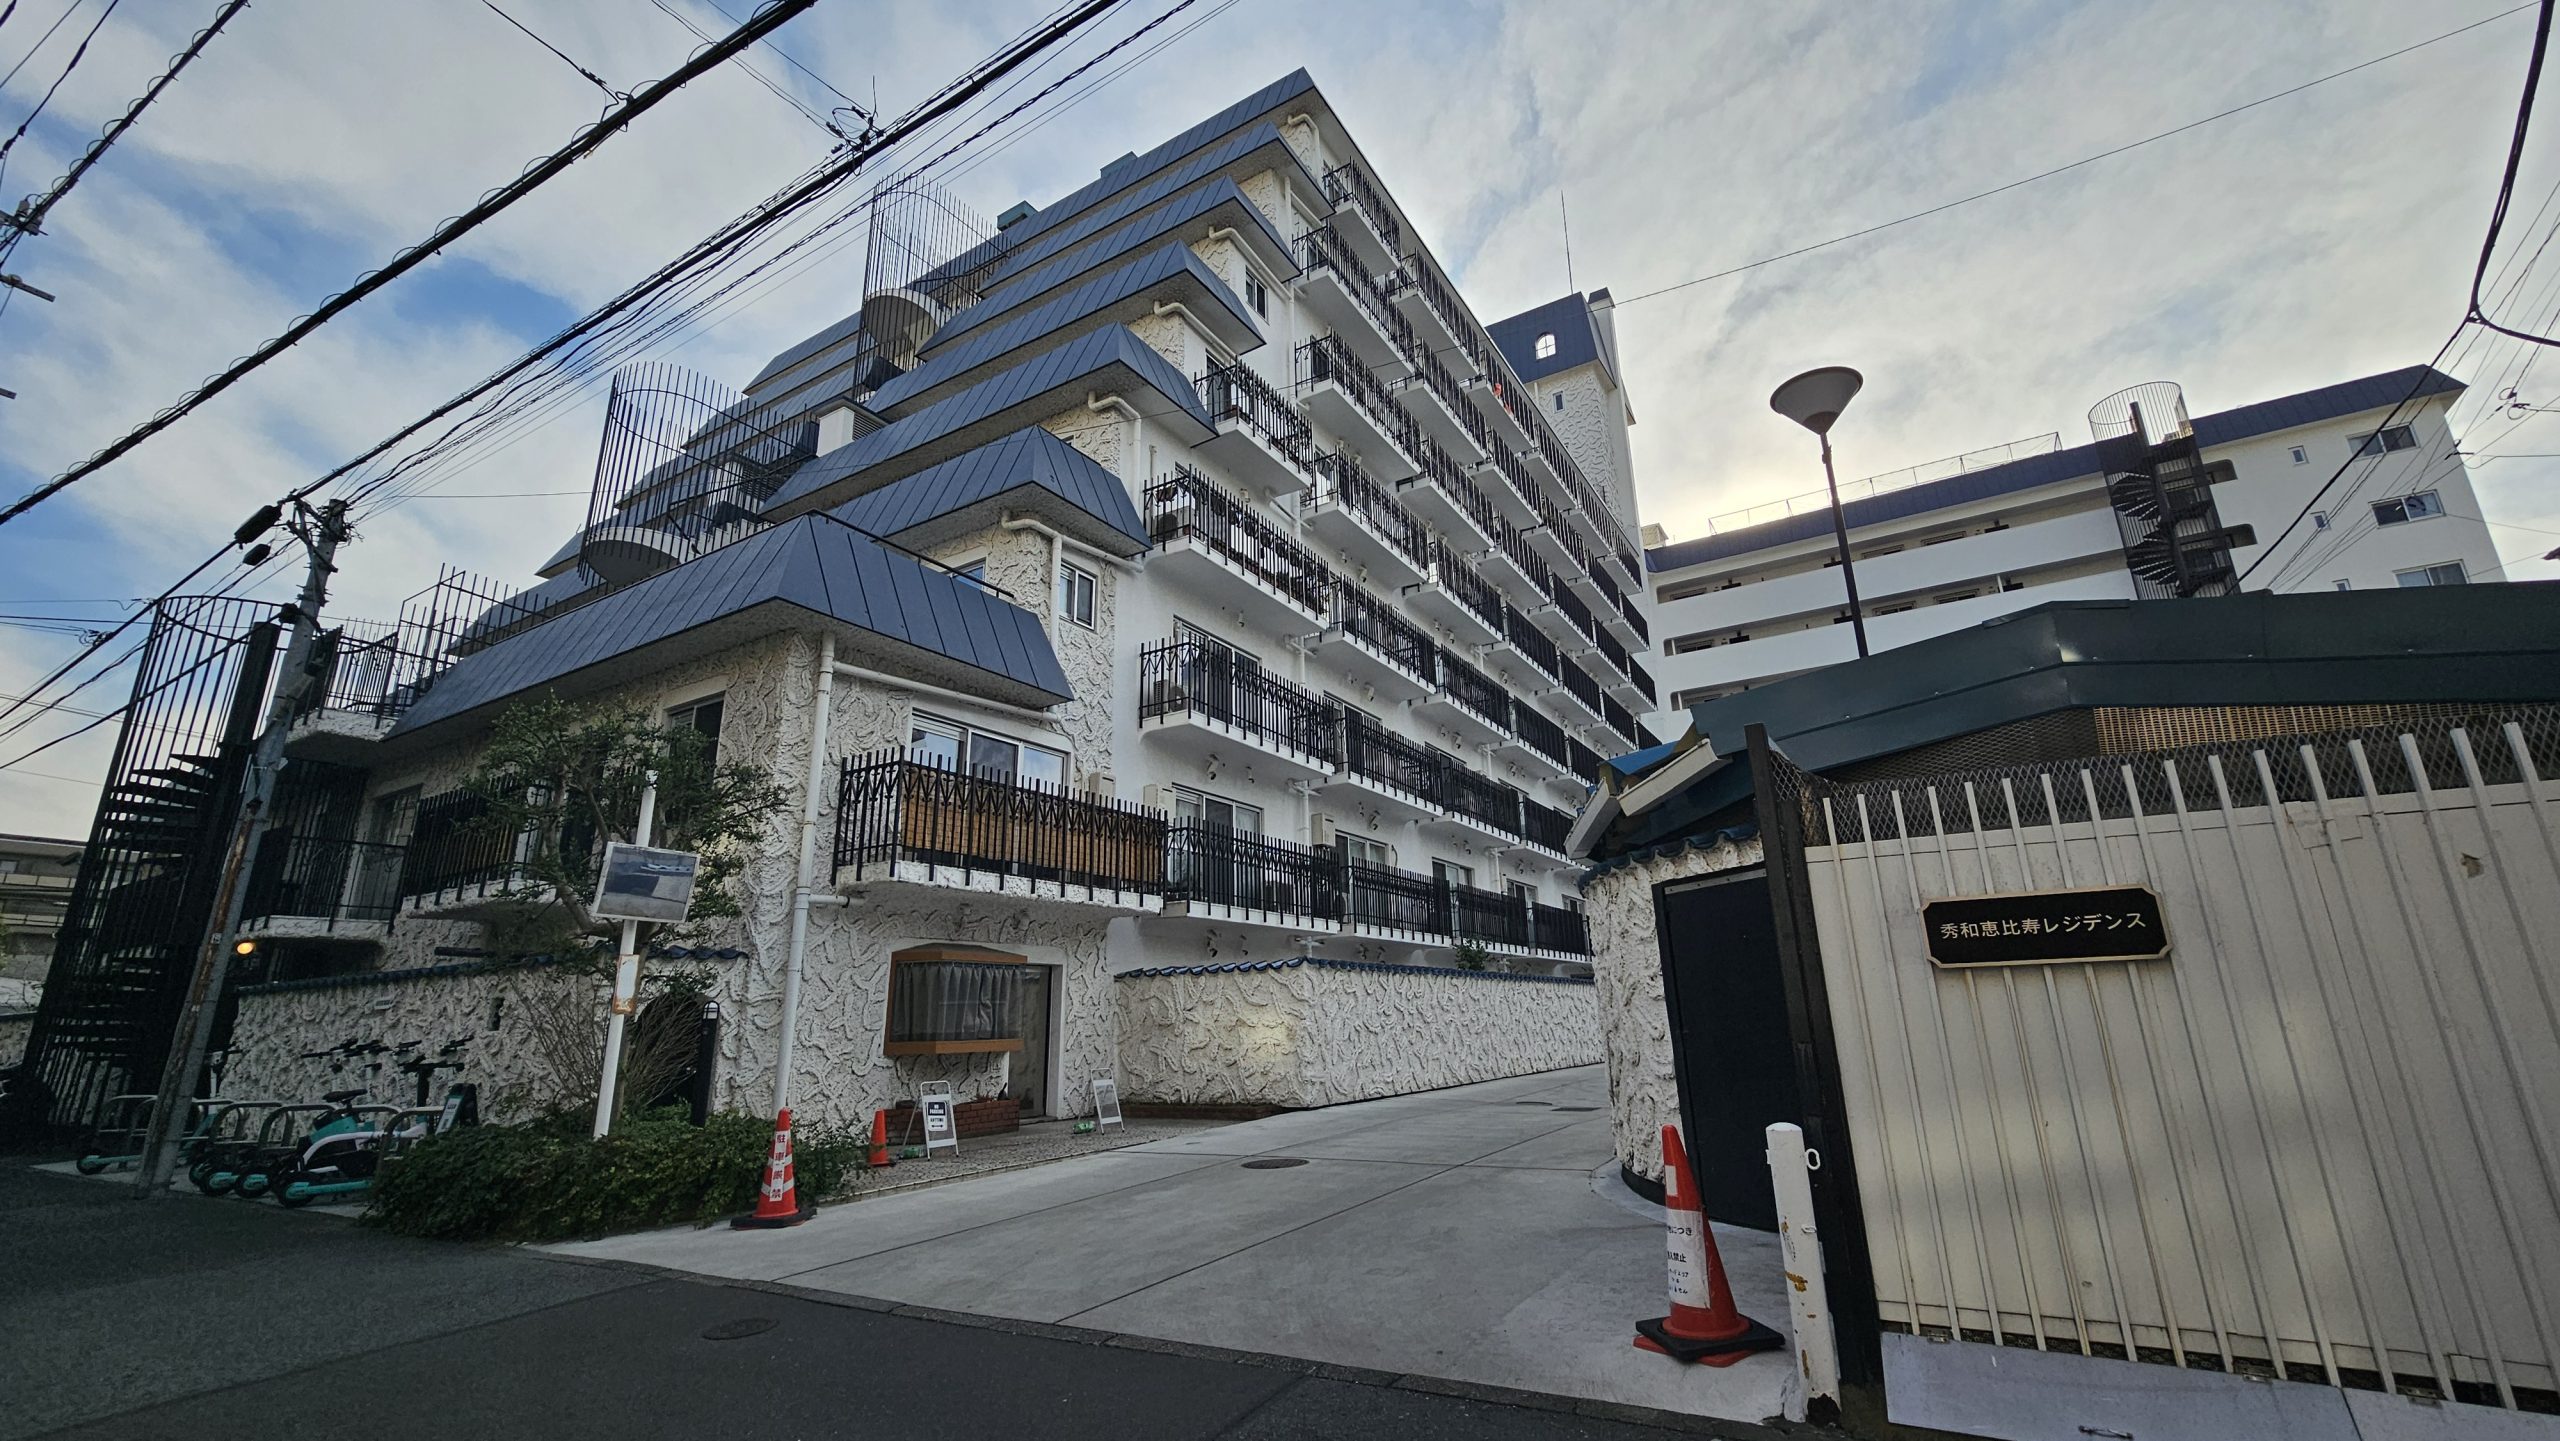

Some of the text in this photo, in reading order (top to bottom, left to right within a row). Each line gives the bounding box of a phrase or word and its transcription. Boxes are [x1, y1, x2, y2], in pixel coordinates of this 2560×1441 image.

[1940, 912, 2147, 940] 秀和恵比寿レジデンス
